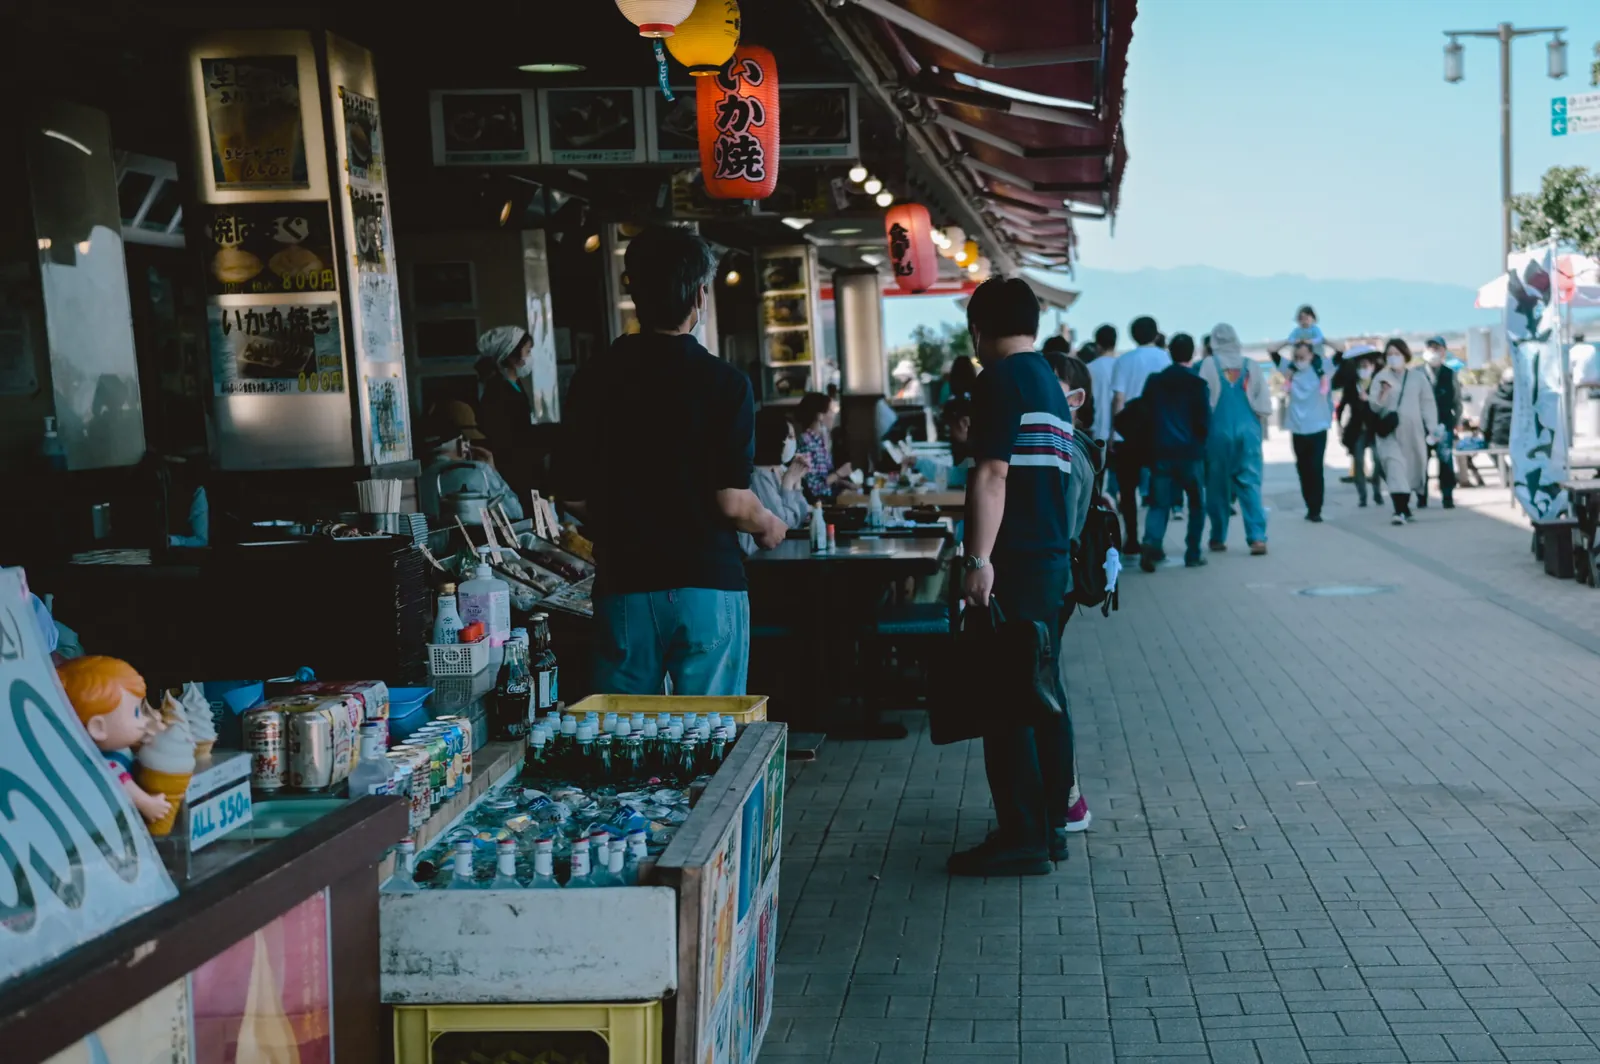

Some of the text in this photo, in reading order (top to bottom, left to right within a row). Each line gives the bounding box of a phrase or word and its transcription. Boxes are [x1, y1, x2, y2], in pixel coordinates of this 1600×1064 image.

[714, 54, 766, 182] いか焼
[282, 269, 335, 290] 800円
[222, 306, 331, 335] いか丸焼き
[297, 369, 343, 393] 800円
[192, 806, 215, 840] ALL
